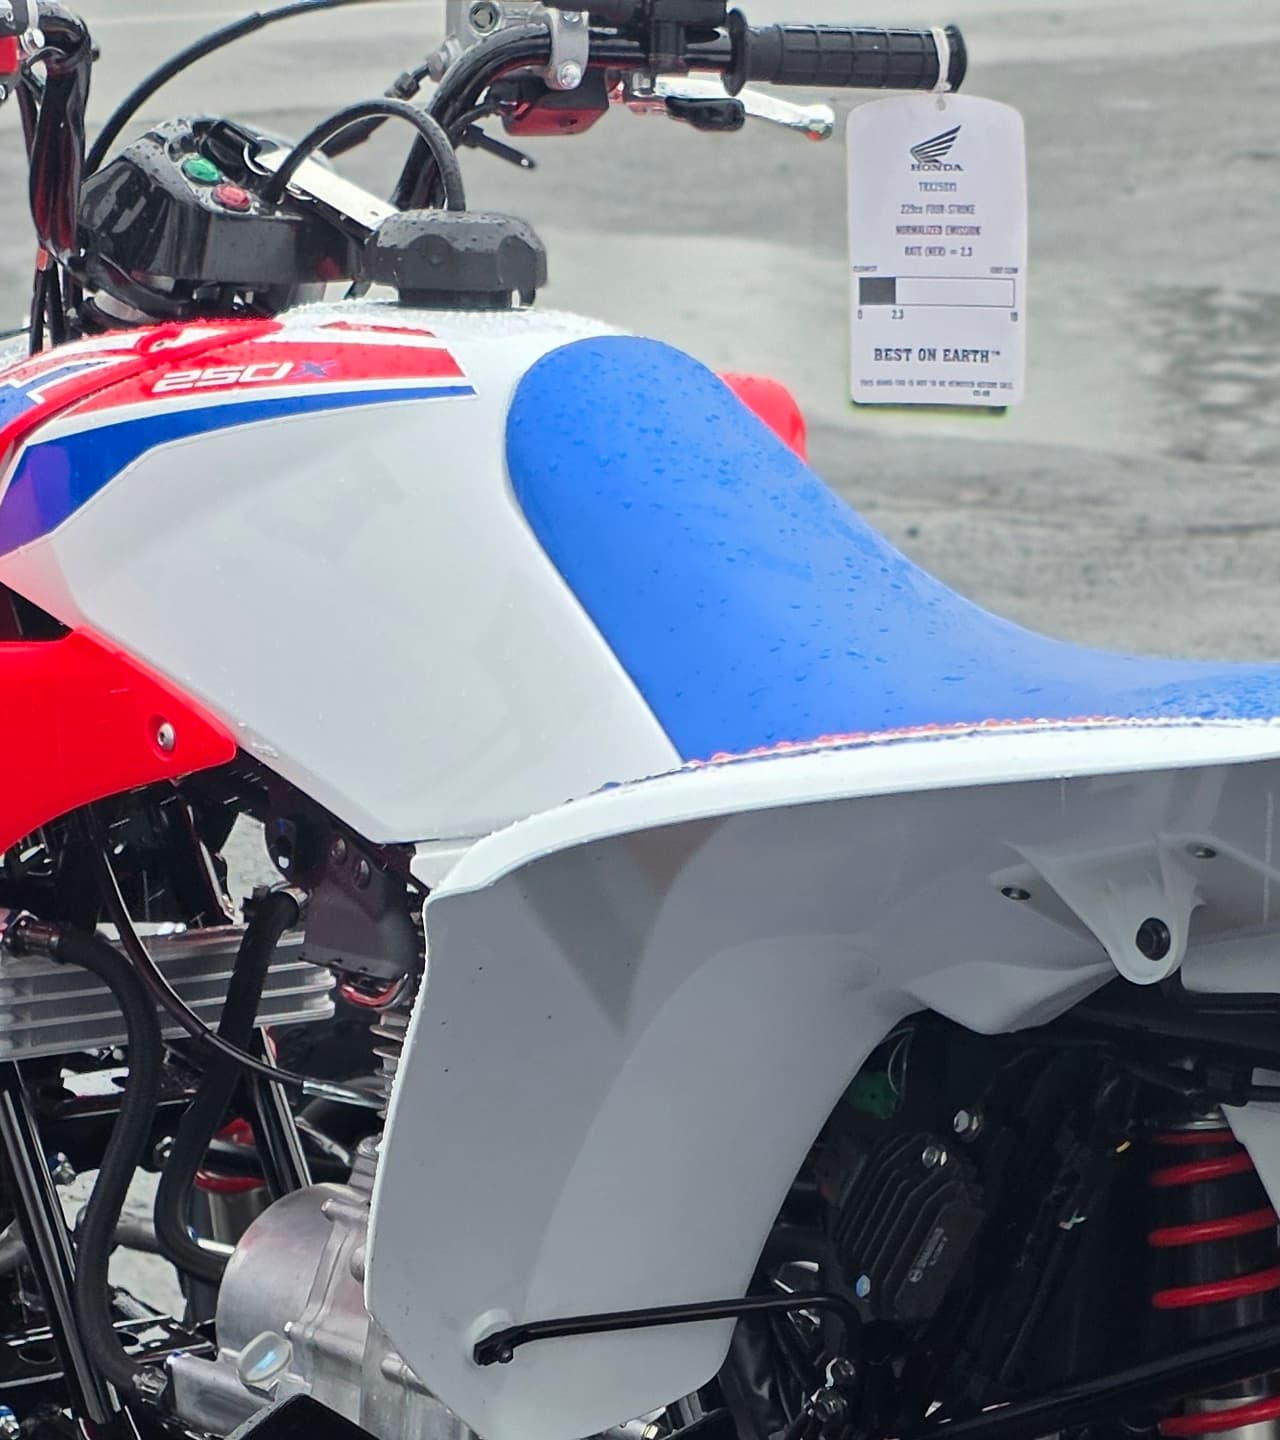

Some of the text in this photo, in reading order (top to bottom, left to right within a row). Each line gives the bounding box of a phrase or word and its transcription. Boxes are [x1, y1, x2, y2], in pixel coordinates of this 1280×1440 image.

[911, 163, 964, 171] HONDA
[874, 348, 912, 362] BEST
[918, 348, 937, 362] ON
